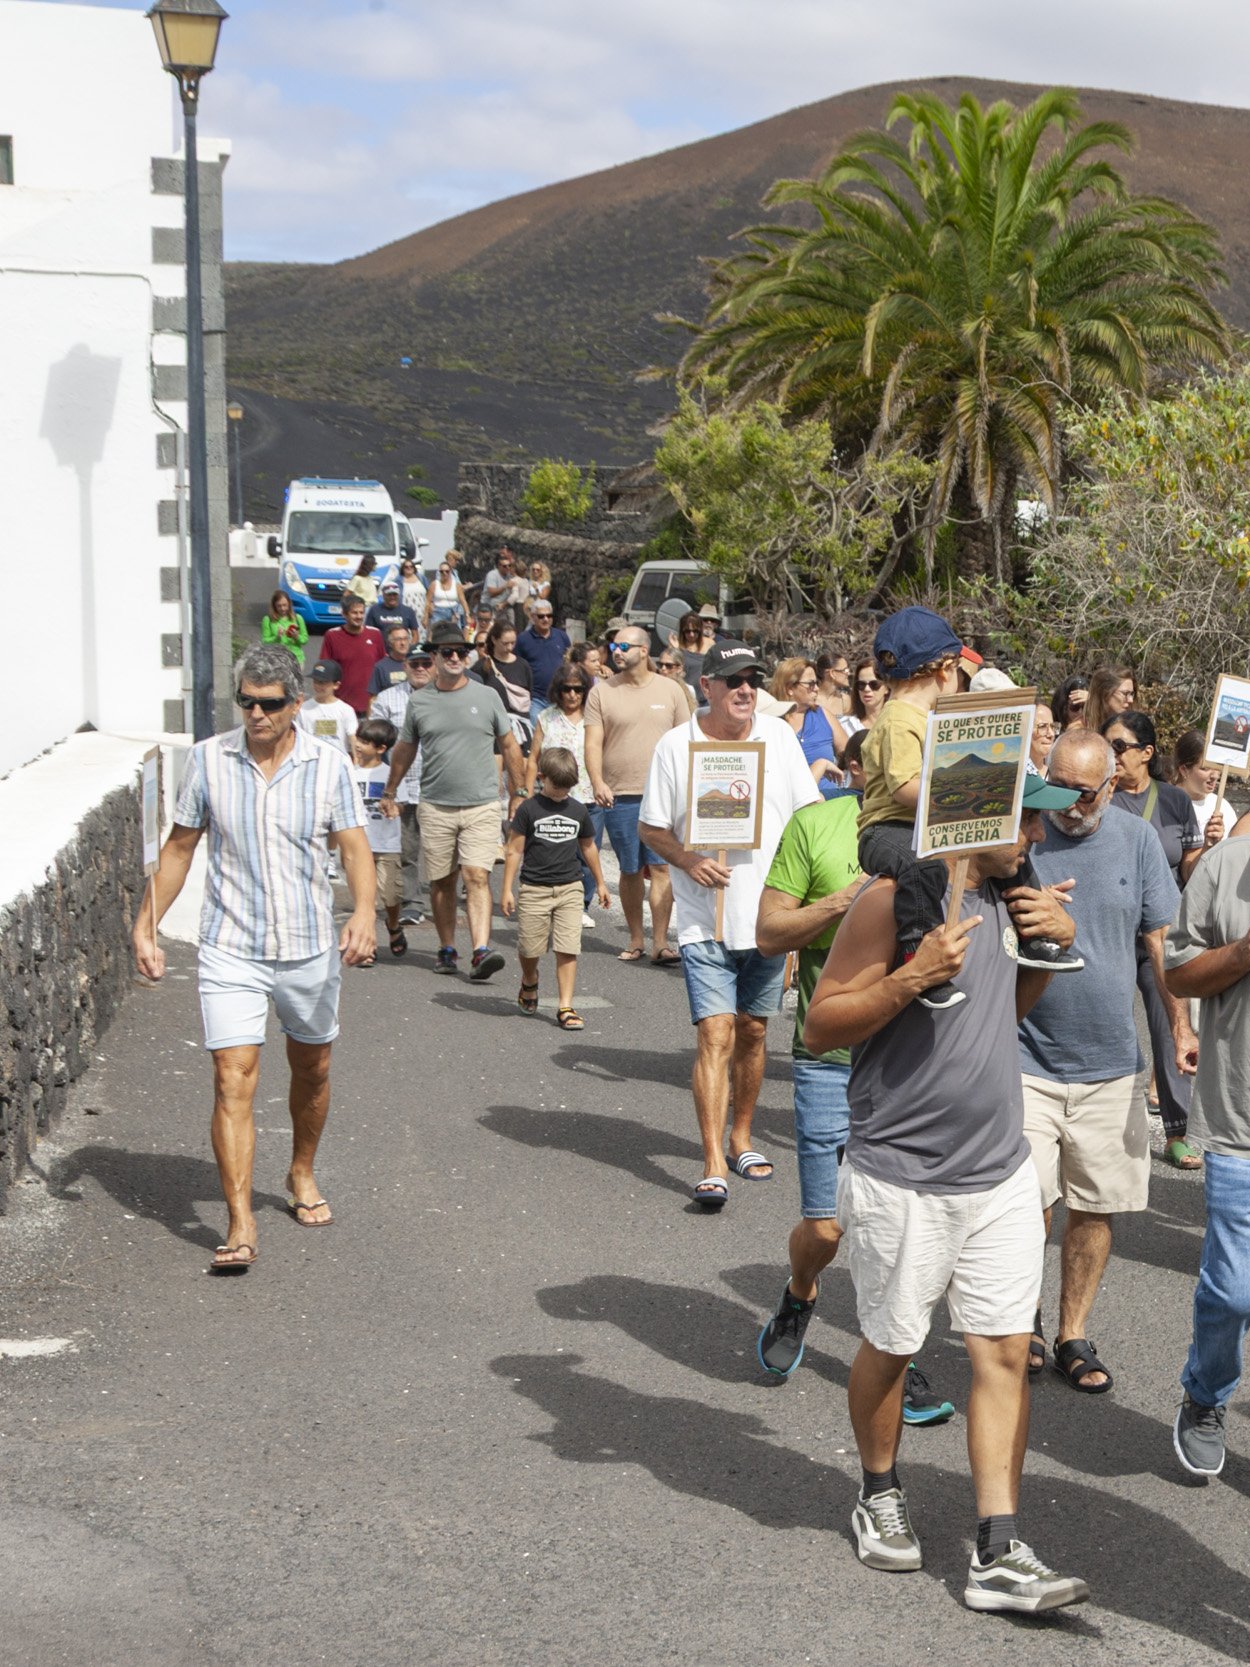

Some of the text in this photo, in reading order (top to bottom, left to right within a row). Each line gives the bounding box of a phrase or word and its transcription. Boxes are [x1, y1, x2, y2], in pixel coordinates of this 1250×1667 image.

[938, 712, 1022, 730] LO QUE SE QUIERE
[937, 723, 1021, 743] SE PROTEGE
[539, 824, 576, 835] Billabong
[928, 818, 1003, 837] CONSERVEMOS
[931, 828, 1000, 849] LA GERIA
[848, 862, 864, 875] M
